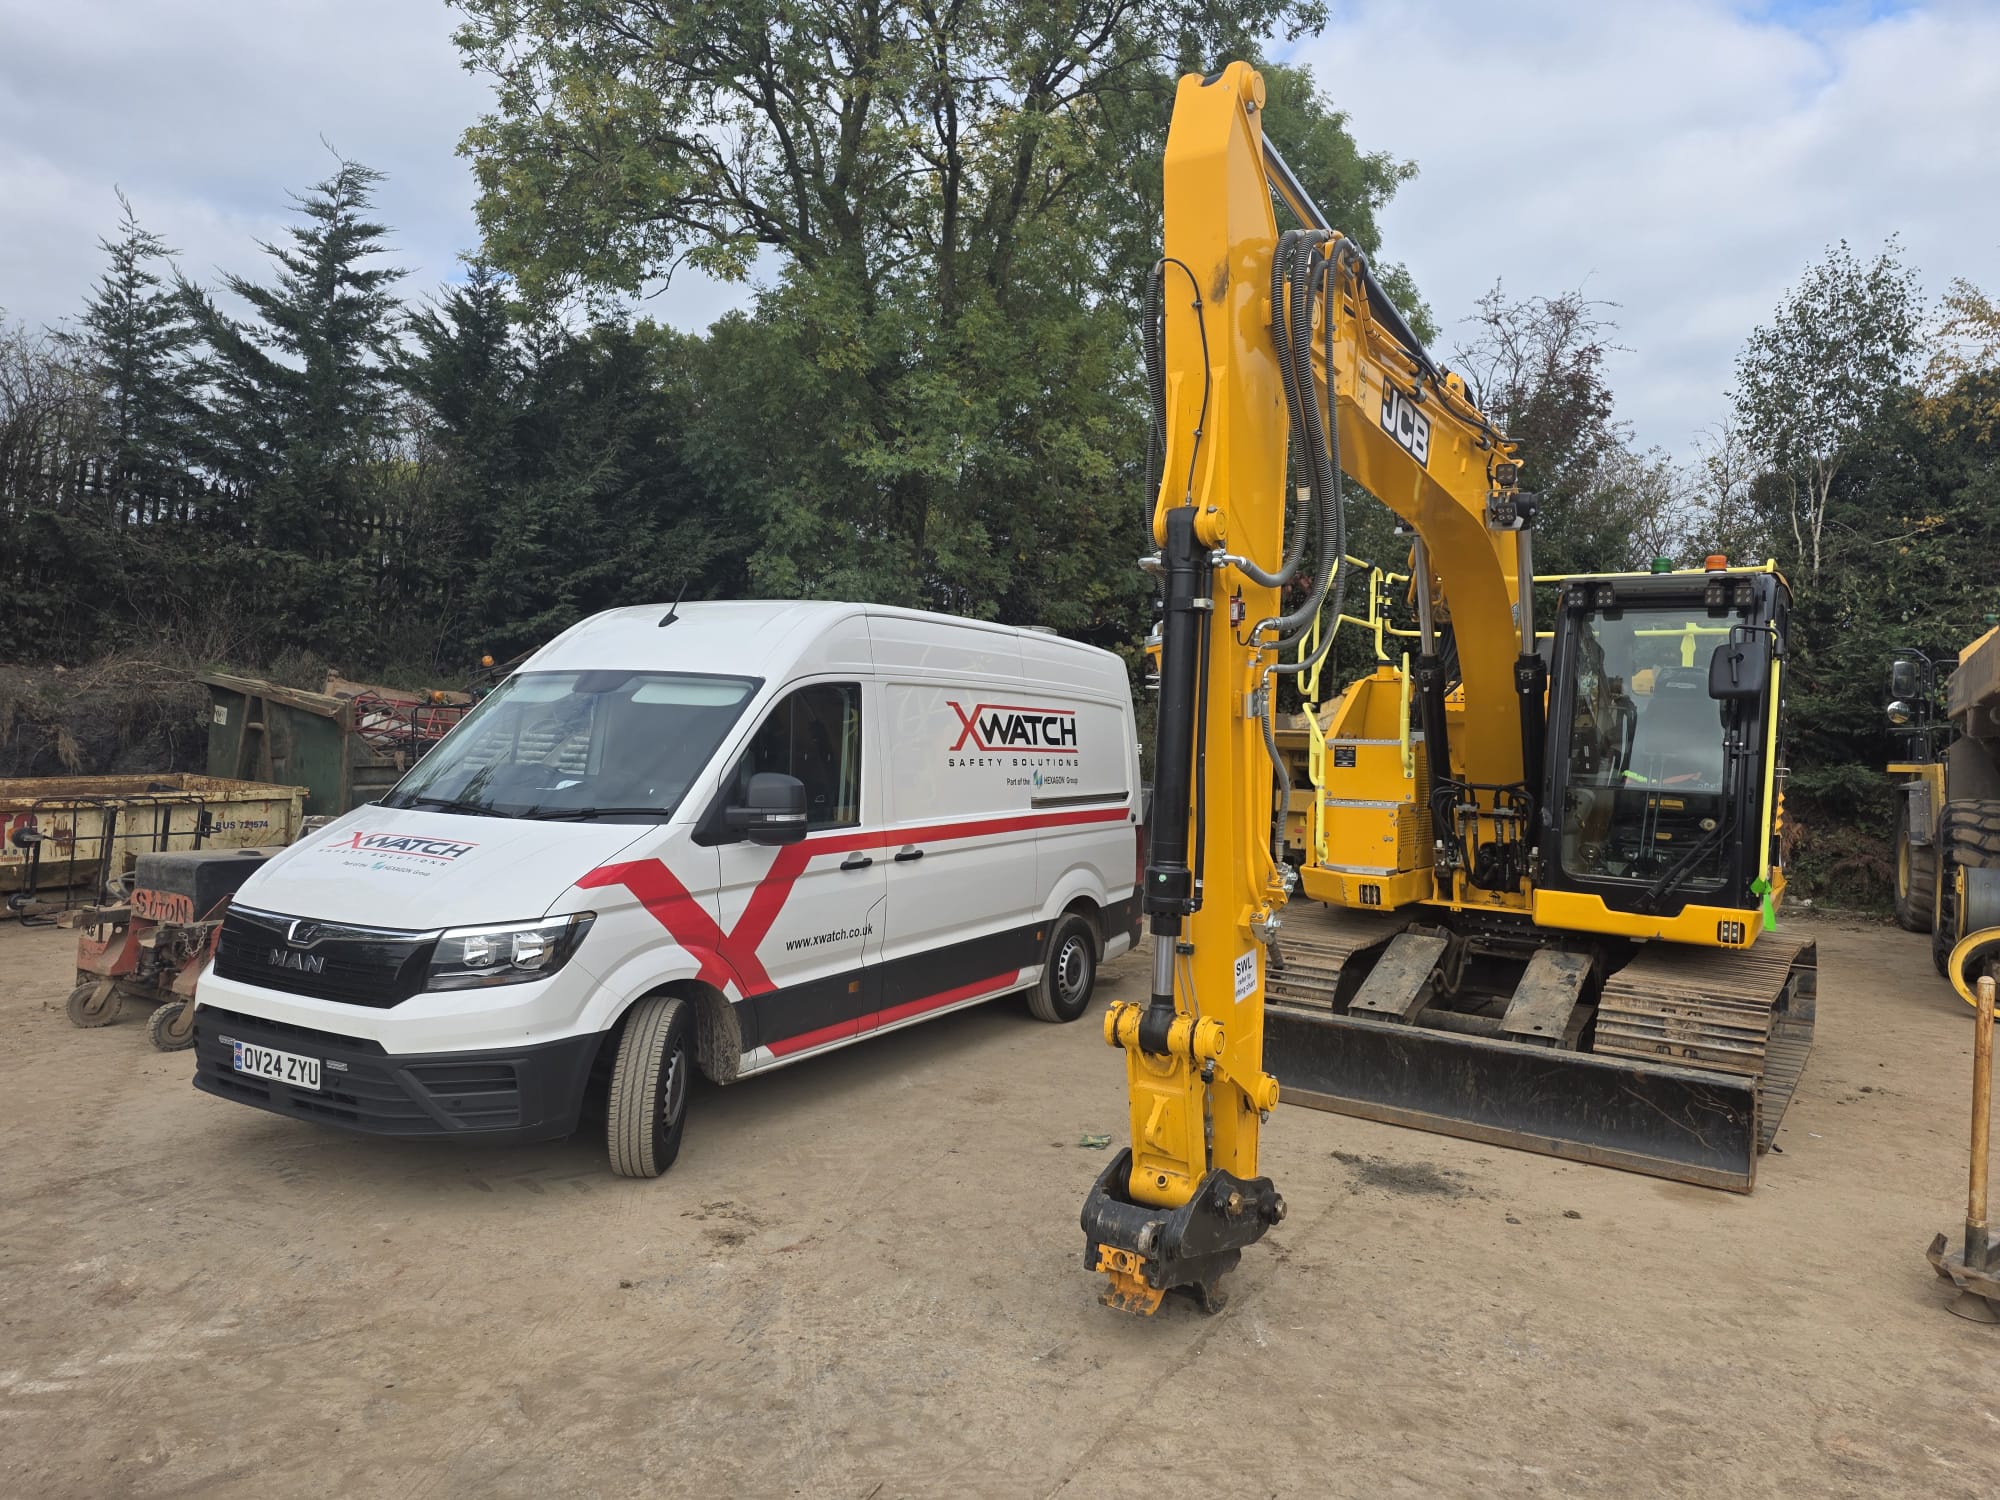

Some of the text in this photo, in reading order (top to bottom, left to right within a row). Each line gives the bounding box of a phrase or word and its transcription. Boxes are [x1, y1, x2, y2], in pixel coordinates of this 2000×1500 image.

[1382, 389, 1429, 464] JCB
[945, 701, 1079, 753] XWATCH
[948, 758, 1079, 767] SAFETY SOLUTIONS
[1006, 777, 1017, 786] Part
[1023, 777, 1031, 786] the
[1043, 776, 1065, 785] HEXAGON
[1066, 776, 1078, 785] Group
[328, 832, 480, 861] XWATCH
[371, 852, 448, 867] SOLUTIONS
[785, 922, 873, 951] www.xwatch.co.uk
[268, 948, 327, 974] MAN
[1236, 956, 1253, 977] SWL
[244, 1047, 319, 1086] OV24 ZYU
